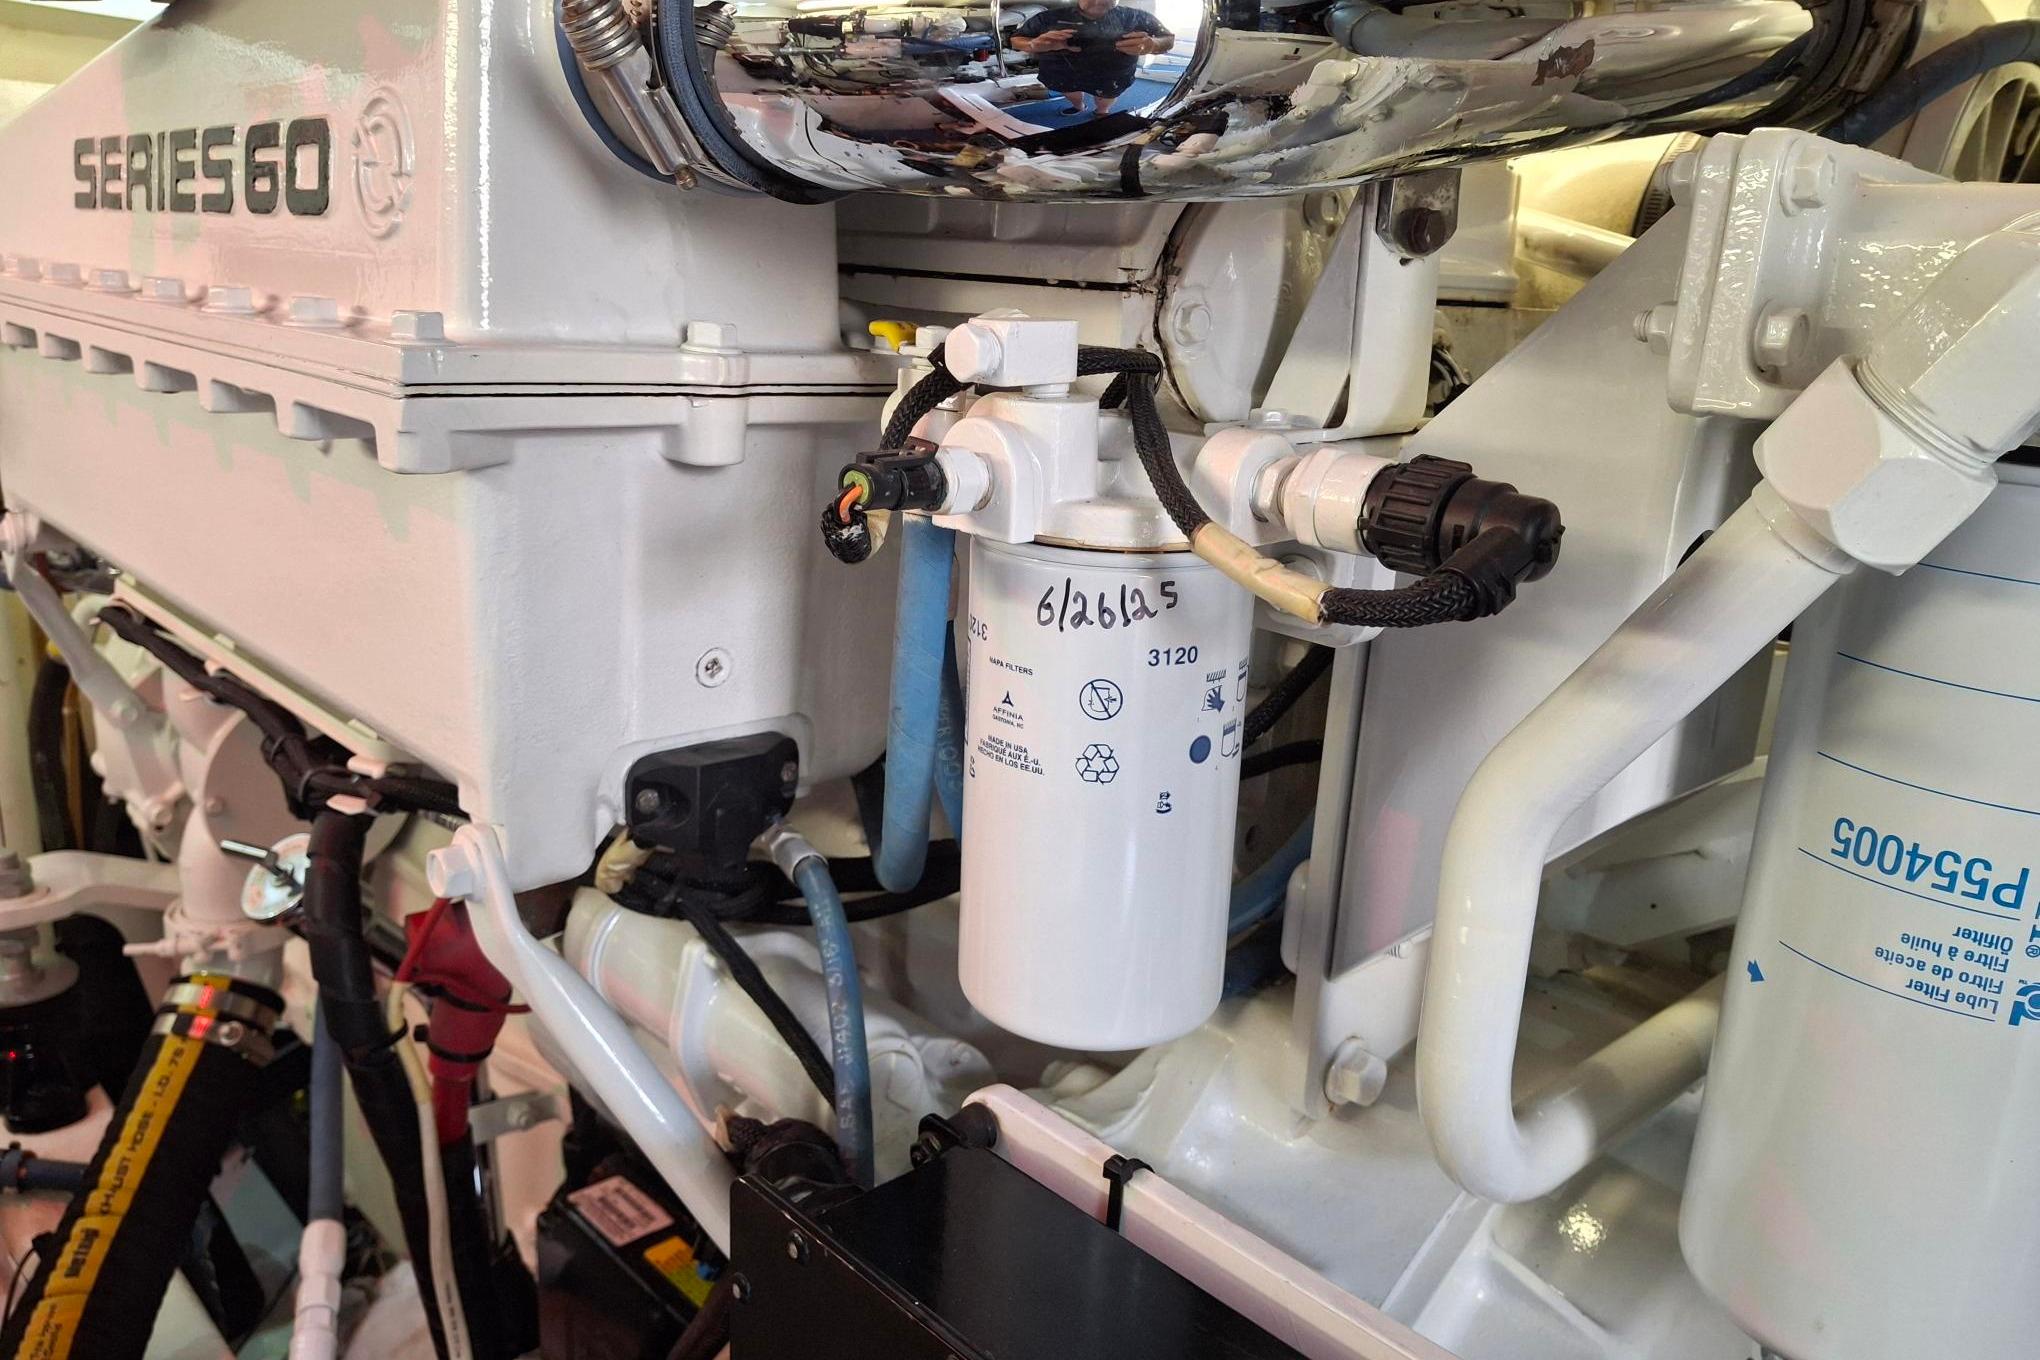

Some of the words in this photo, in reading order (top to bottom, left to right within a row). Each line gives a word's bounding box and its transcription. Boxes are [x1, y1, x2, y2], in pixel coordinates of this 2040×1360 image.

[74, 126, 235, 214] SERIES
[1037, 576, 1178, 633] 6/26/25
[970, 613, 988, 641] 312
[1147, 645, 1198, 667] 3120
[1005, 662, 1033, 676] FILTERS
[992, 706, 1024, 721] AFFINIA
[988, 734, 1004, 747] MADE
[1005, 741, 1012, 750] IN
[1013, 743, 1029, 754] USA
[1008, 751, 1022, 761] AUX
[995, 754, 1004, 763] EN
[1004, 759, 1019, 769] LOS
[1831, 817, 2030, 910] P554005
[1900, 932, 1943, 957] huile
[1952, 926, 2014, 956] Ölfilter
[1874, 946, 1927, 972] aceite
[1947, 946, 1959, 962] à
[1963, 949, 2010, 973] Filtre
[1931, 964, 1954, 982] de
[1958, 970, 2005, 995] Filtro
[1905, 978, 1950, 1003] Filter
[1954, 991, 2000, 1015] Lube
